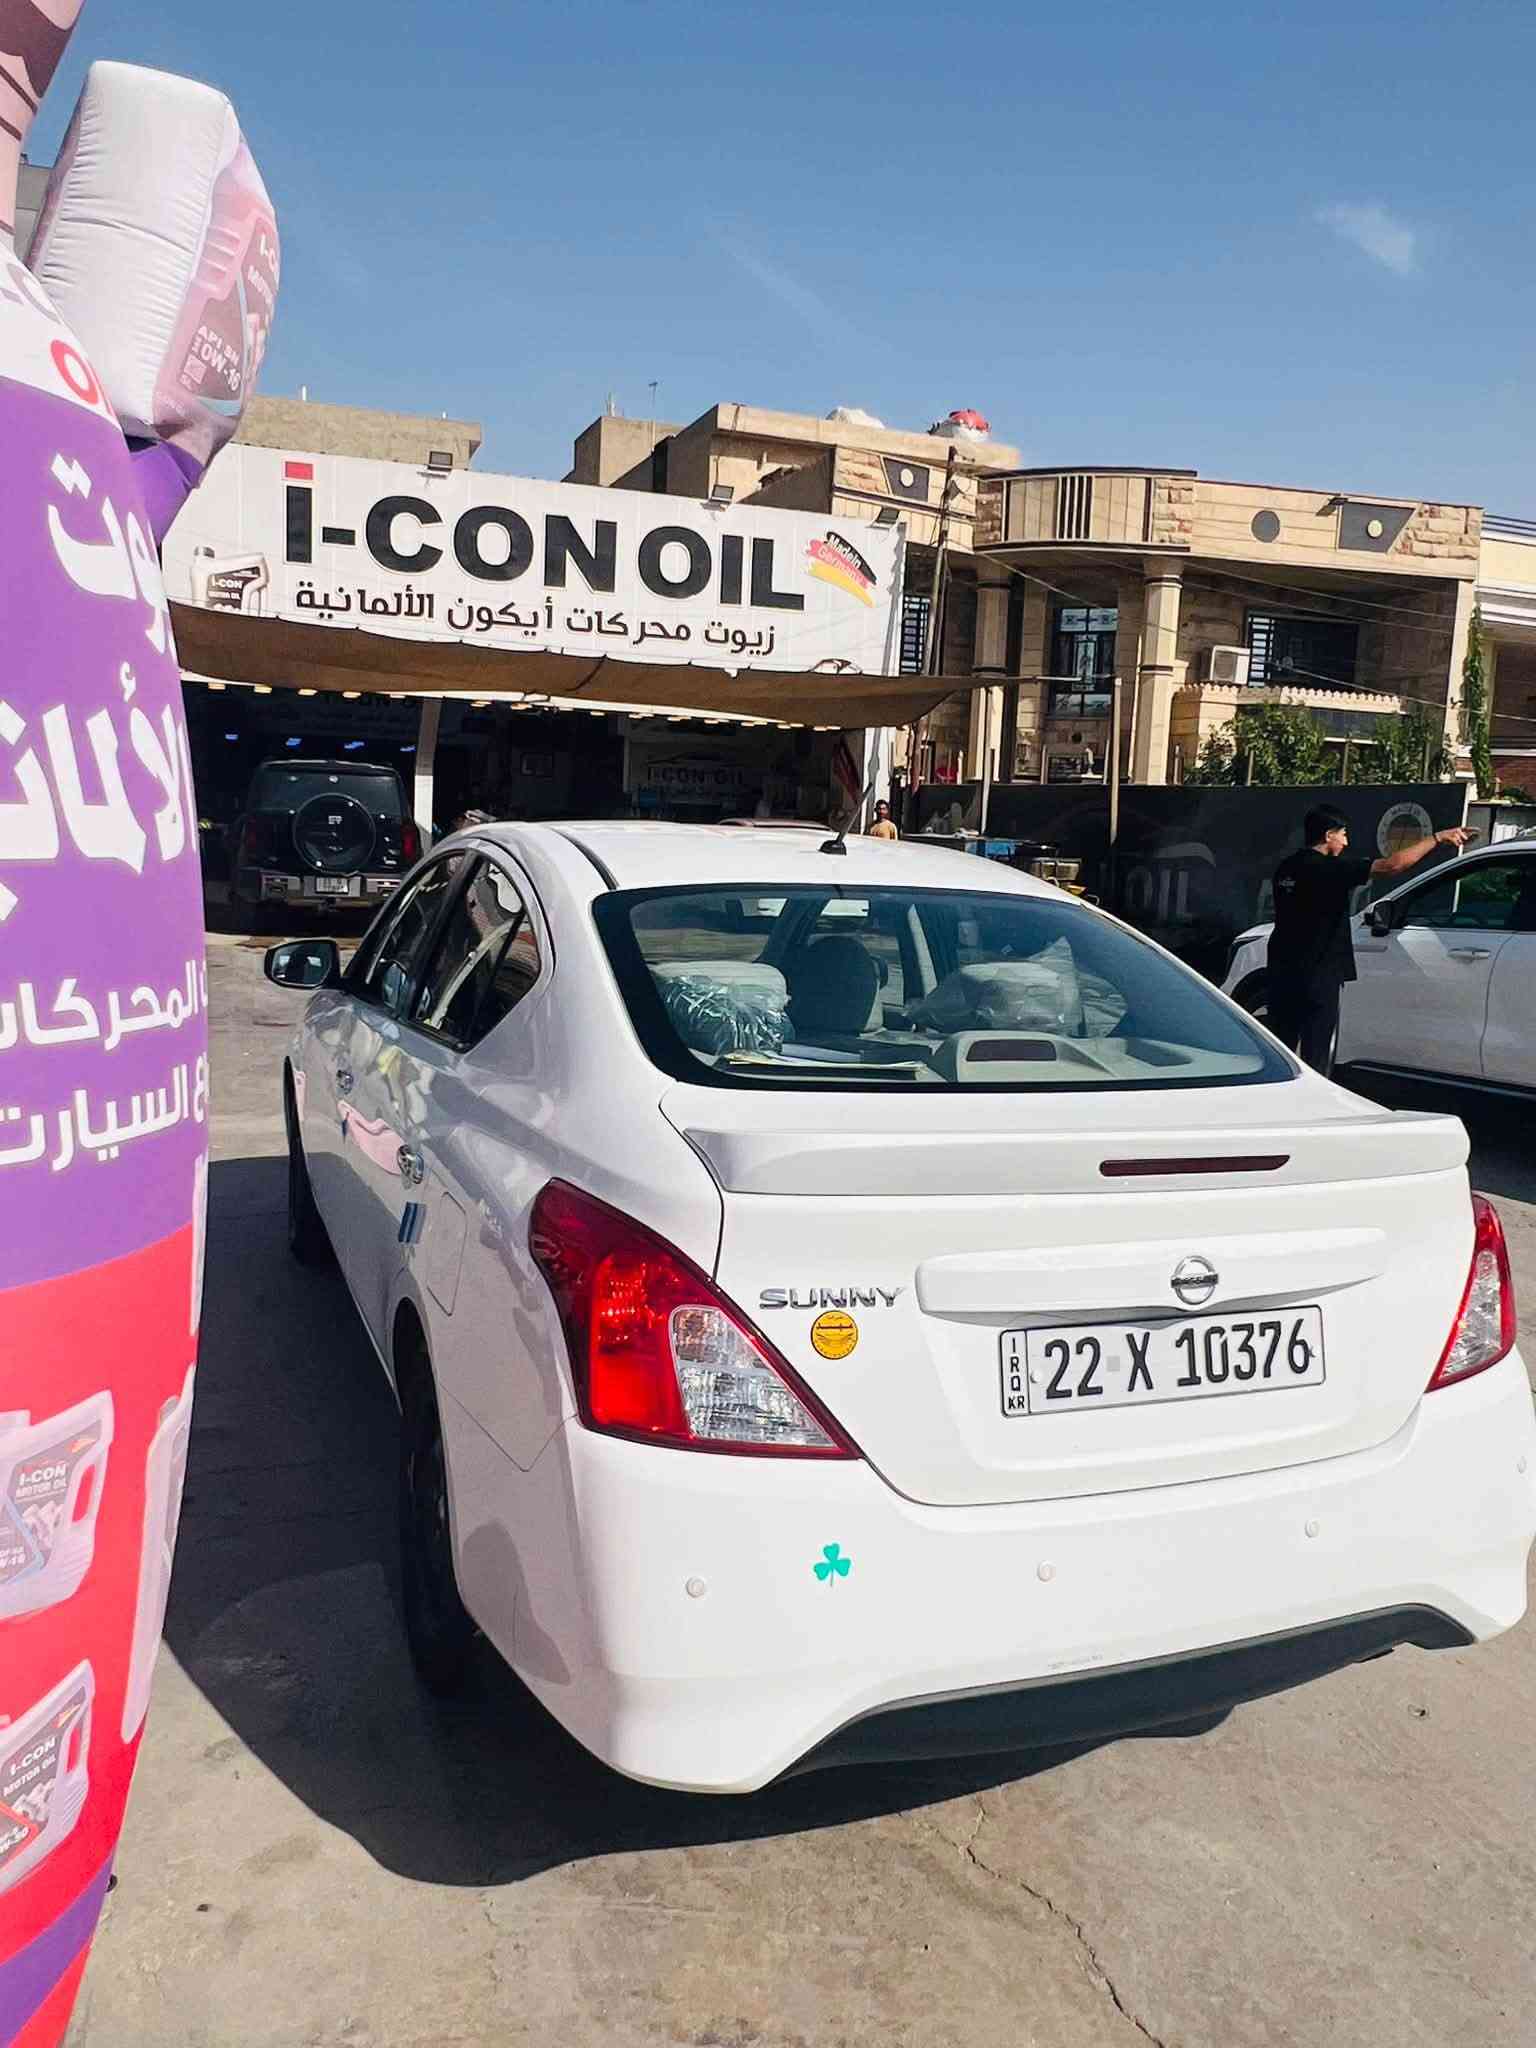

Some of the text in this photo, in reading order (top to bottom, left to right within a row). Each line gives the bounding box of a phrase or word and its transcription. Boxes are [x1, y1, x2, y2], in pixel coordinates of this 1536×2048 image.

[211, 576, 243, 588] I-CON
[638, 526, 805, 611] OIL
[295, 581, 776, 657] زيوت محركات أيكون الألمانية
[759, 1287, 905, 1310] SUNNY
[1044, 1318, 1310, 1400] 22 X 10376
[1008, 1394, 1025, 1410] KR
[18, 1463, 68, 1486] I-CON
[9, 1736, 57, 1777] I-CON
